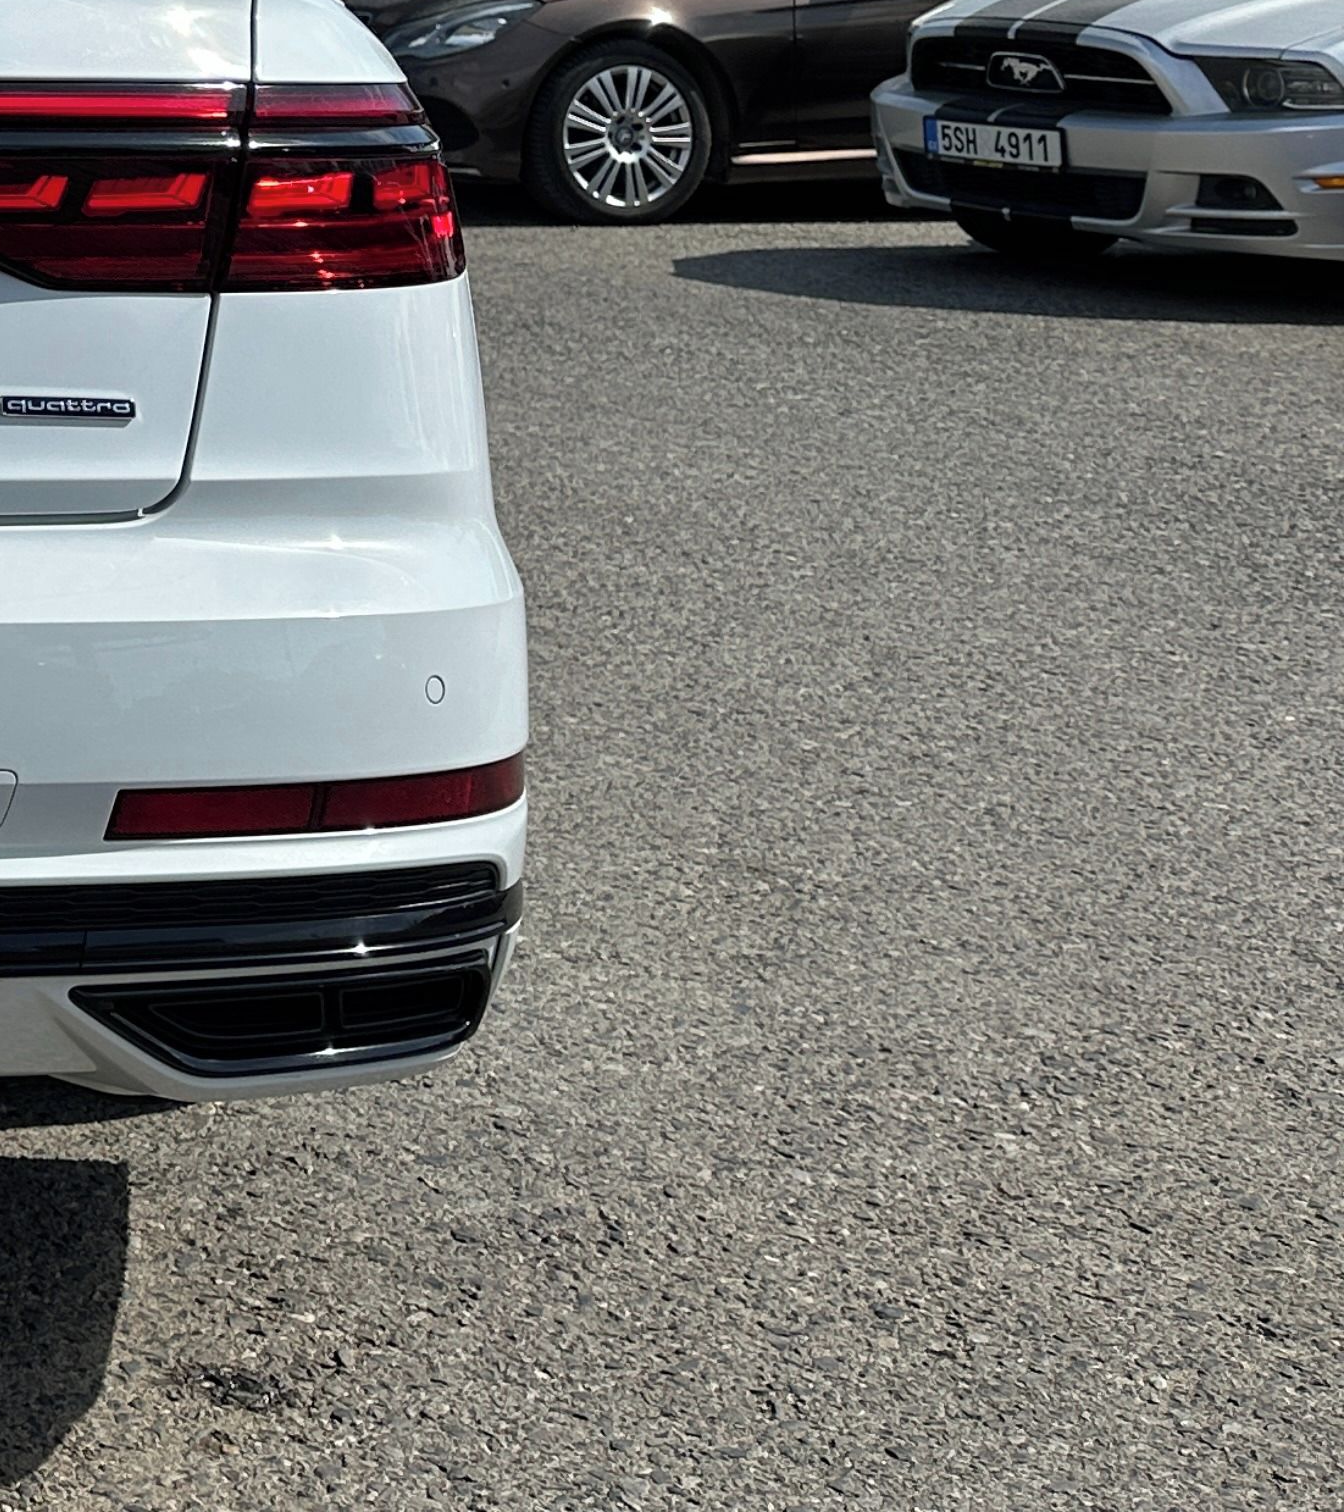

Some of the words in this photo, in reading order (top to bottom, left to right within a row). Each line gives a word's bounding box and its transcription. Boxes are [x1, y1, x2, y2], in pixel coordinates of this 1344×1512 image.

[940, 124, 978, 156] 5SH
[994, 130, 1049, 163] 4911
[7, 398, 132, 414] quattro
